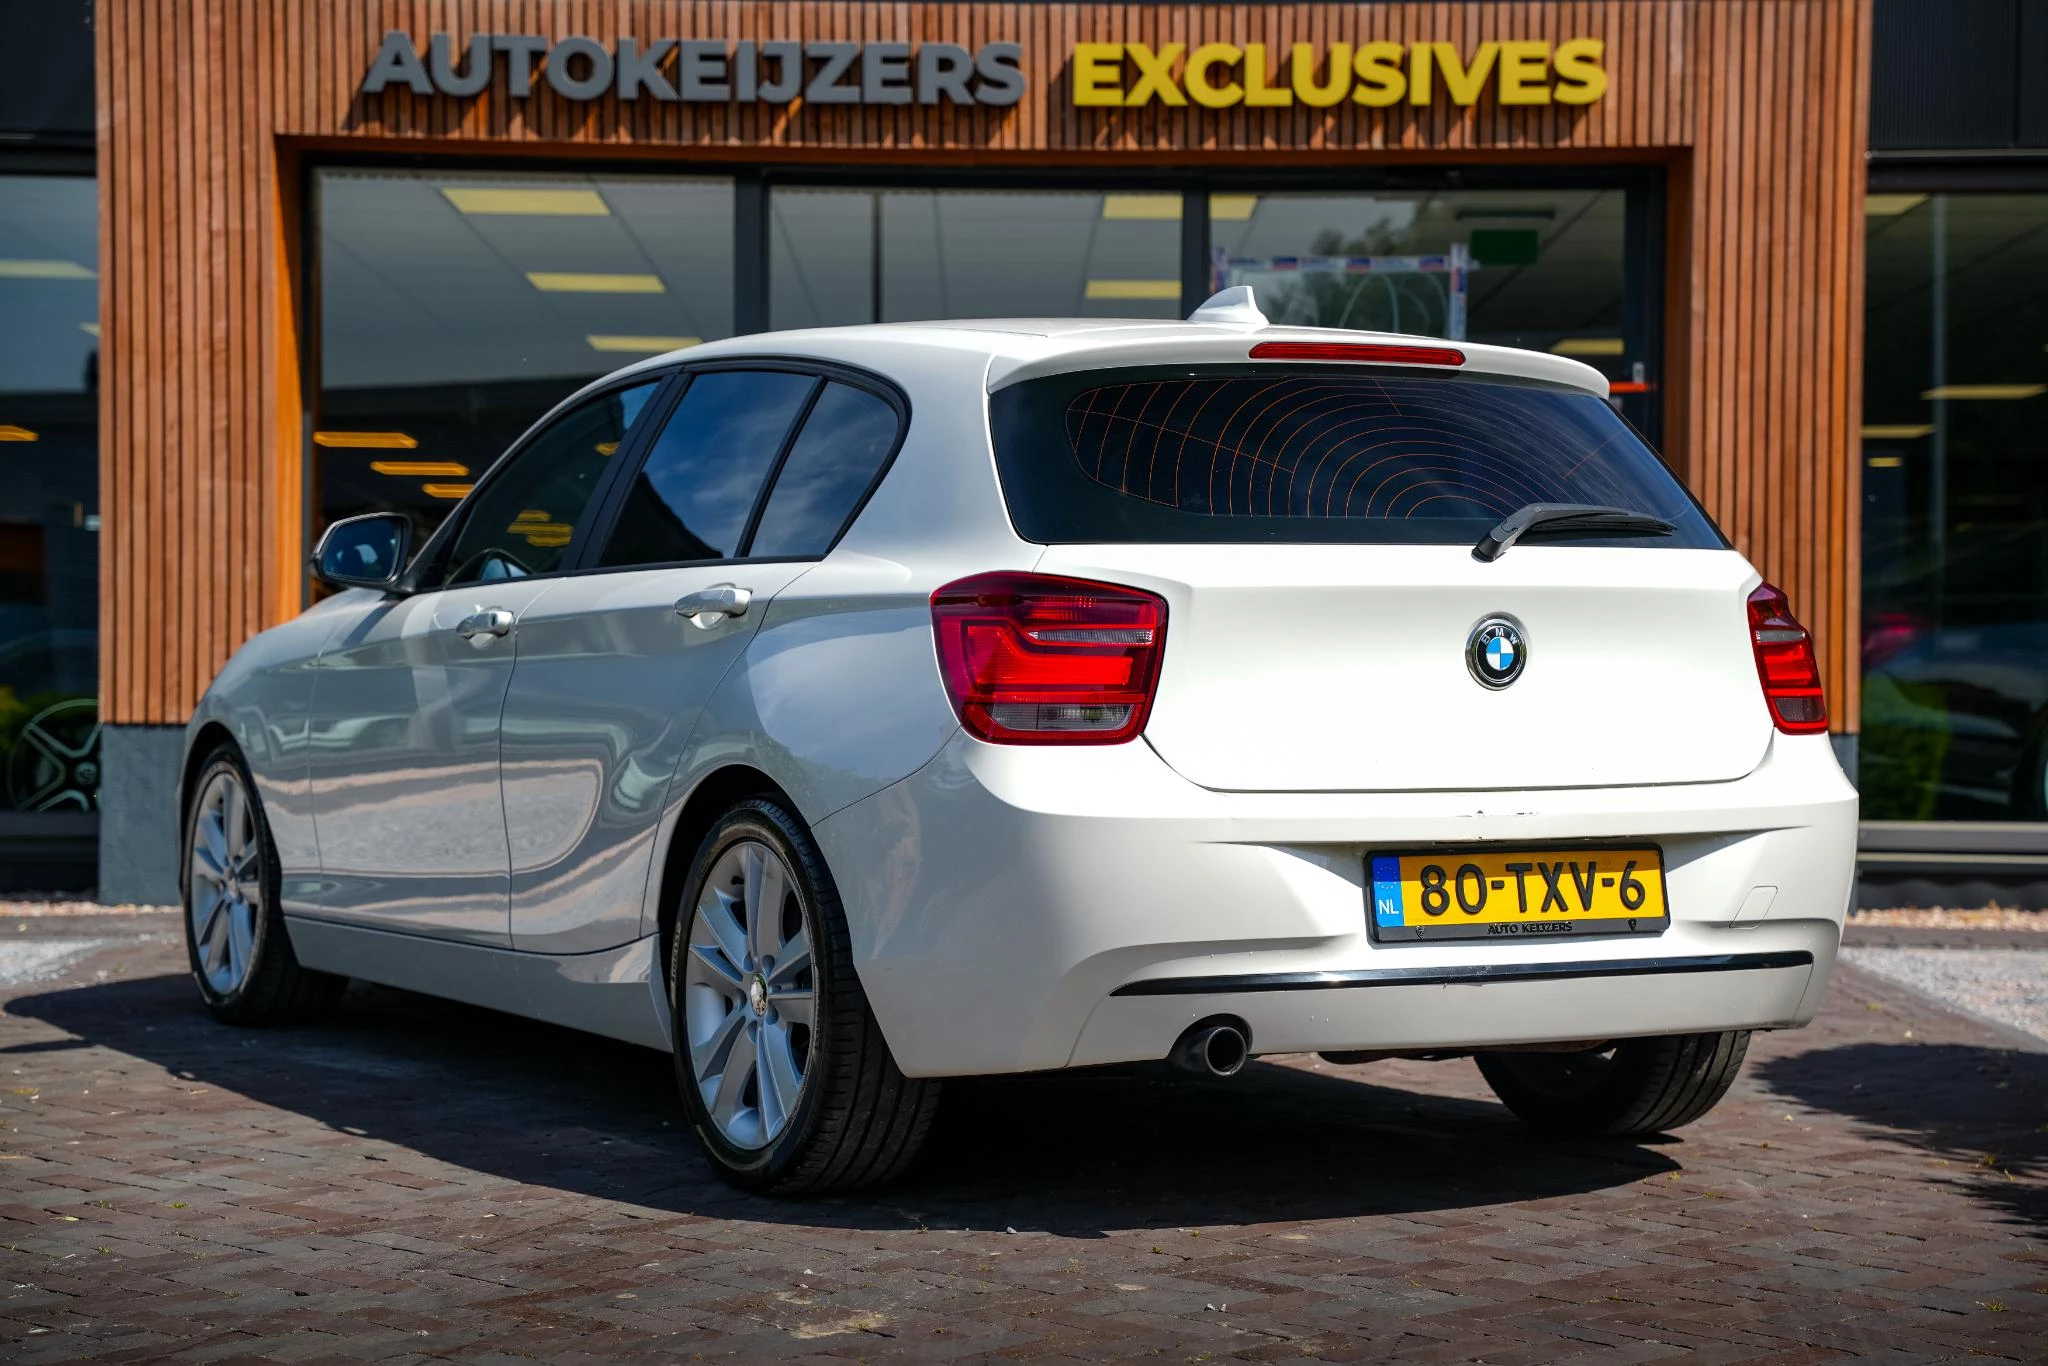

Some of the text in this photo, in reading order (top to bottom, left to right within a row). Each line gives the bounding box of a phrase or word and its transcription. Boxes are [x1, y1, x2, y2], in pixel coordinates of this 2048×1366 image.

[362, 29, 1608, 108] AUTOKEIJZERS EXCLUSIVES
[1481, 627, 1519, 645] BMW
[1420, 860, 1646, 917] 80-TXV-6
[1378, 898, 1400, 915] NL
[1487, 921, 1573, 935] AUTO KEIJZERS
